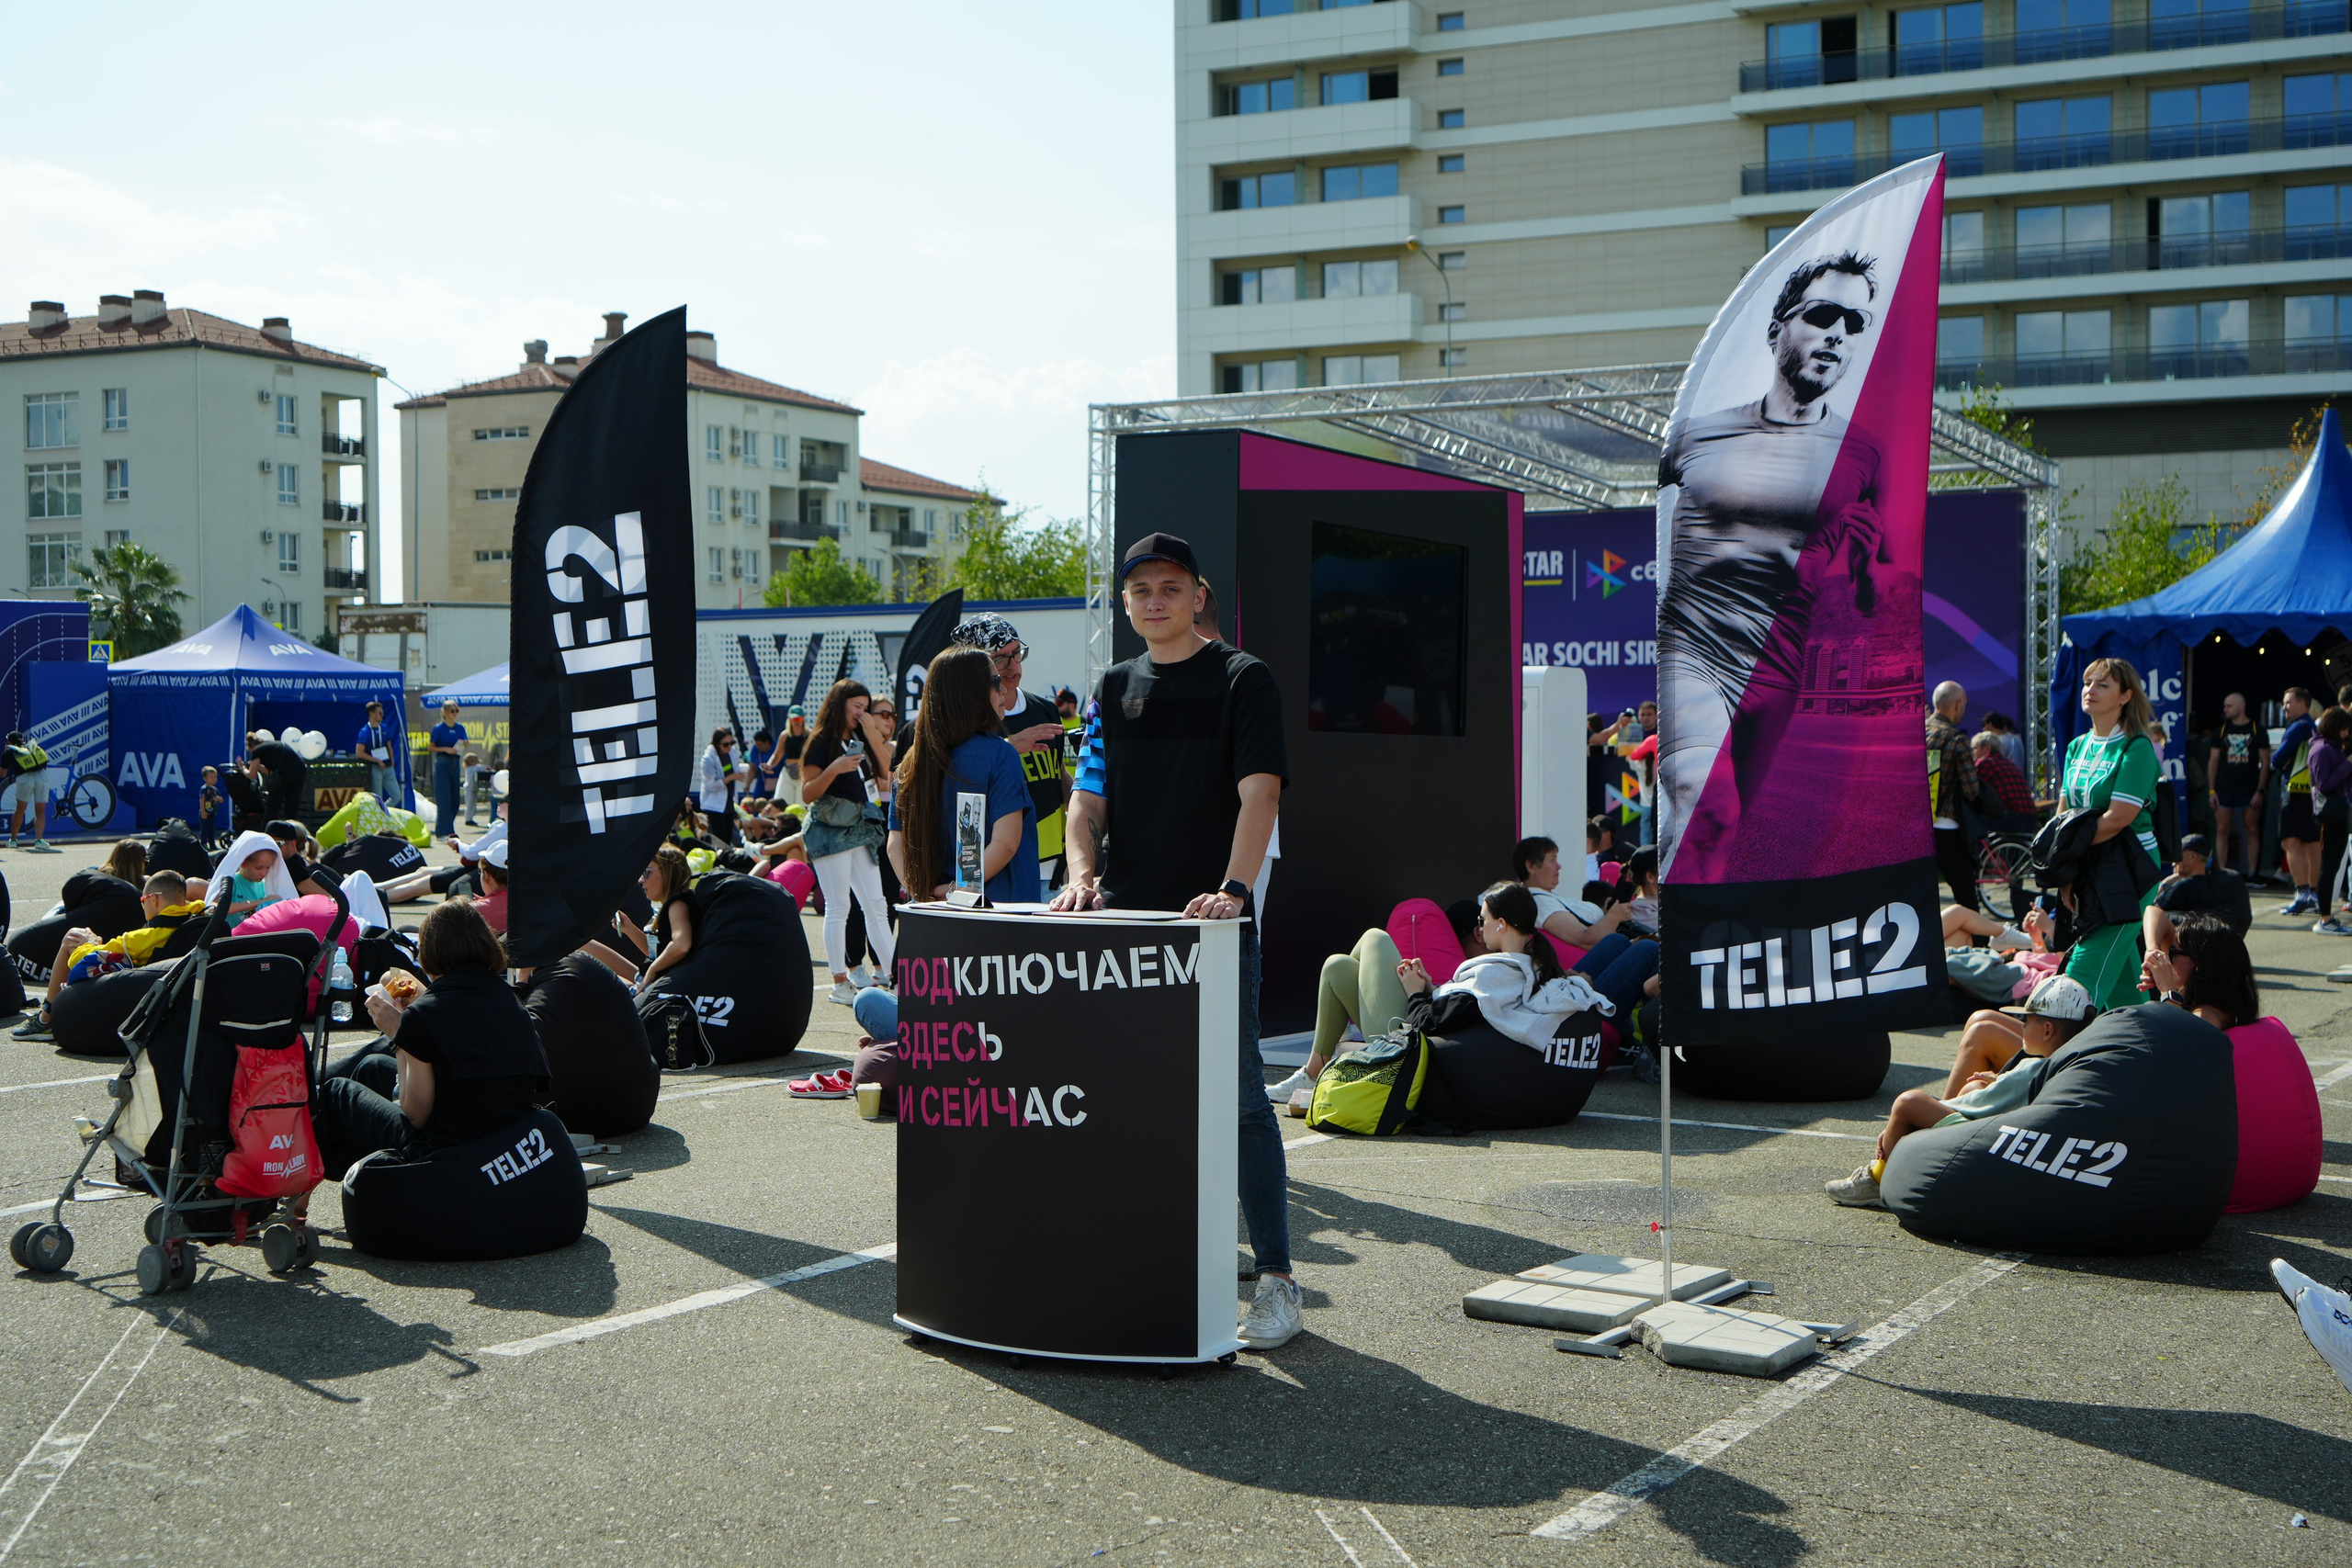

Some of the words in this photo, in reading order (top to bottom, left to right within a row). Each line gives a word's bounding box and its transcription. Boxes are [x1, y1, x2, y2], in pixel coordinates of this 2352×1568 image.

[1523, 550, 1563, 577] TAR
[170, 643, 213, 656] AVA
[268, 643, 313, 656] AVA
[1553, 641, 1619, 666] SOCHI
[140, 675, 158, 686] AVA
[198, 676, 217, 687] AVA
[240, 676, 261, 687] AVA
[305, 678, 326, 689] AVA
[369, 678, 390, 689] AVA
[545, 511, 658, 834] TELE2
[117, 751, 187, 789] AVA
[1020, 748, 1062, 783] EDIA
[389, 843, 421, 868] TELE2
[17, 953, 52, 982] TELE
[1690, 901, 1928, 1010] TELE2
[897, 942, 1201, 1005] ПОДКЛЮЧАЕМ
[897, 1021, 1003, 1069] ЗДЕСЬ
[1544, 1032, 1601, 1069] TELE2
[898, 1085, 914, 1124] И
[921, 1077, 1088, 1128] СЕЙЧАС
[269, 1134, 294, 1150] AV
[480, 1128, 554, 1186] TELE2
[1988, 1124, 2129, 1188] TELE2
[263, 1162, 283, 1172] IRON
[288, 1154, 305, 1168] LADY
